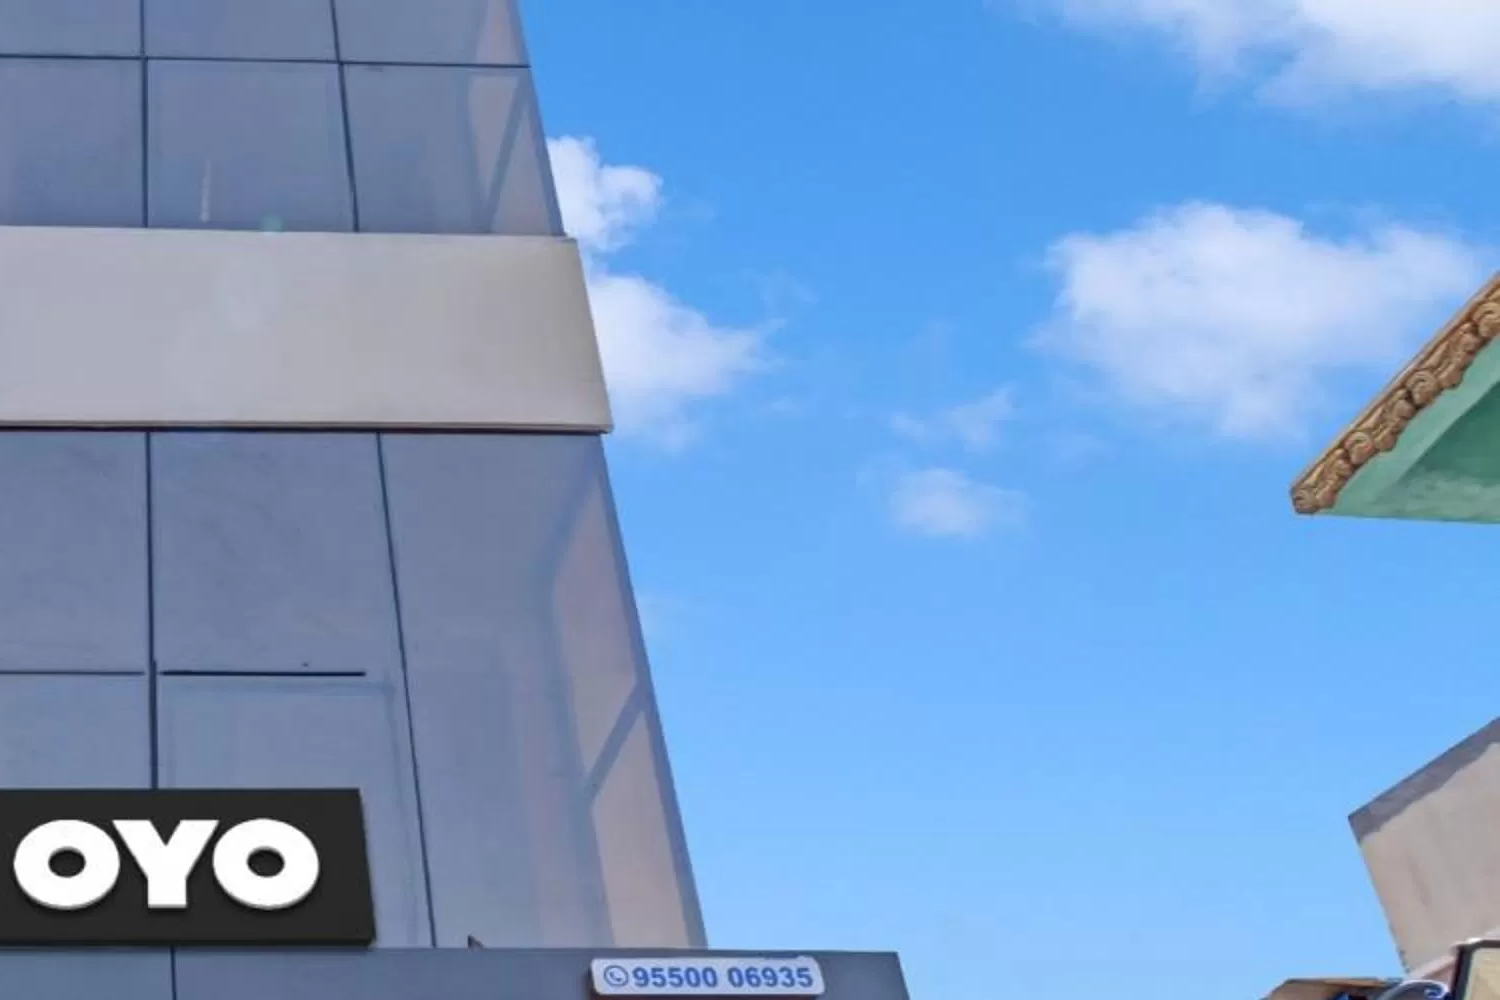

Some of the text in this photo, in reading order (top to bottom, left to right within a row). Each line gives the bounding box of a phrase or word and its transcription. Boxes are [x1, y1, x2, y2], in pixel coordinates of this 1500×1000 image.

[13, 818, 320, 910] OYO
[632, 966, 814, 988] 95500 06935
